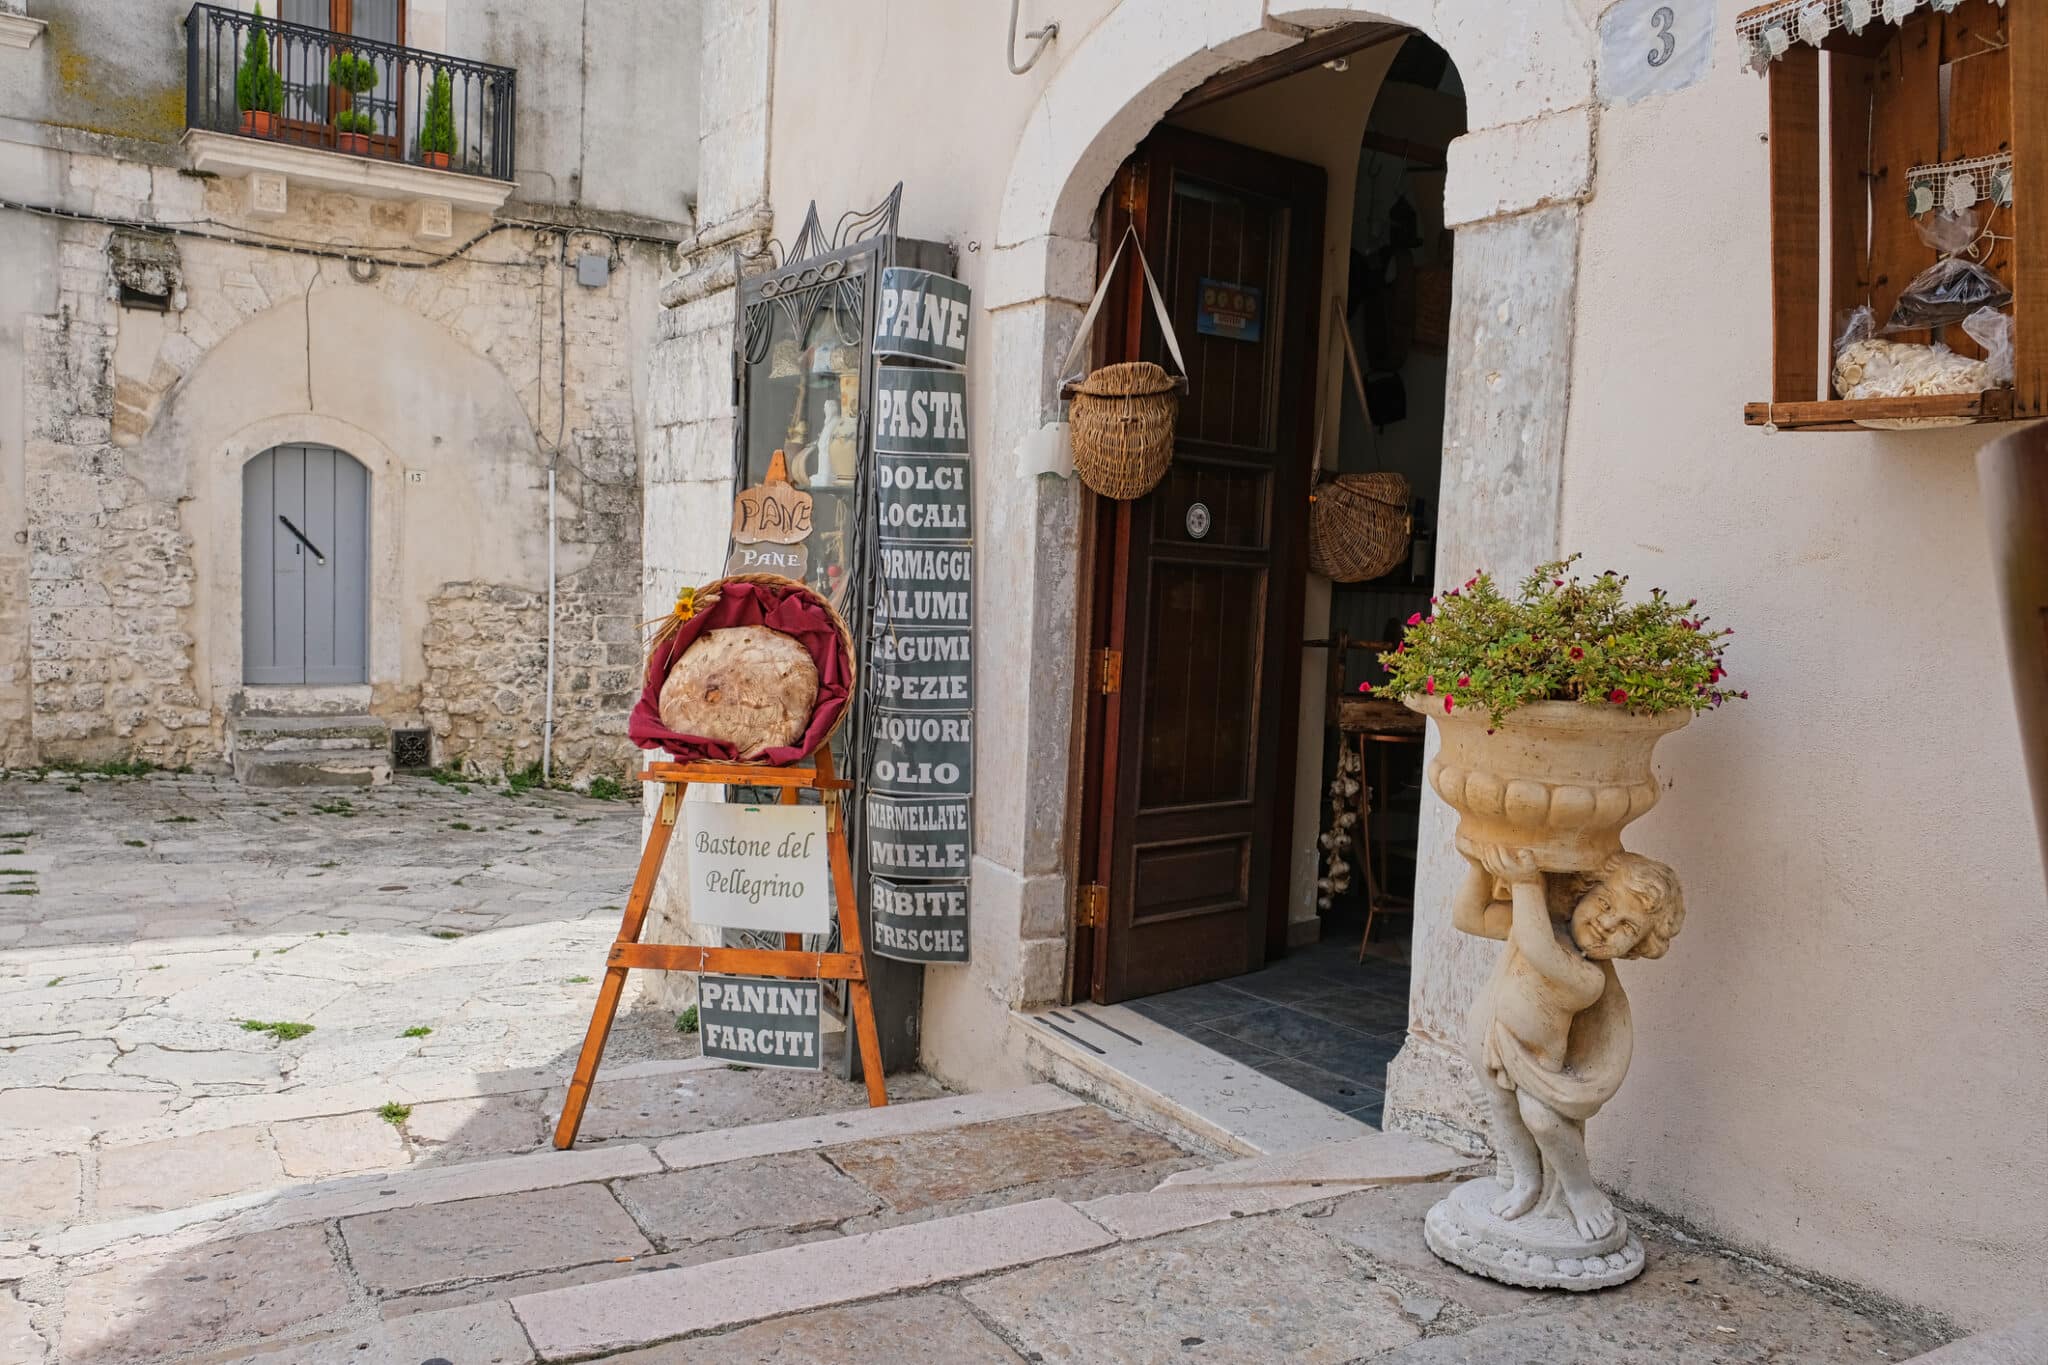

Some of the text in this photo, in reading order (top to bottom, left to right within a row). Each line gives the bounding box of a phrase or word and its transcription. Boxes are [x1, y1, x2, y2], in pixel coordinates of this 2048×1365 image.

[1647, 6, 1675, 67] 3
[878, 288, 968, 351] PANE
[878, 389, 966, 439] PASTA
[880, 465, 964, 490] DOLCI
[740, 496, 811, 534] PANE
[880, 502, 967, 528] LOCALI
[740, 549, 800, 568] PANE
[880, 549, 970, 581] ORMAGGI
[875, 760, 960, 785] OLIO
[869, 802, 967, 831] MARMELLATE
[695, 831, 815, 858] Bastone del
[872, 840, 965, 868] MIELE
[705, 869, 804, 904] Pellegrino
[873, 883, 966, 917] BIBITE
[874, 921, 965, 952] FRESCHE
[700, 982, 818, 1016] PANINI
[705, 1023, 814, 1057] FARCITI
